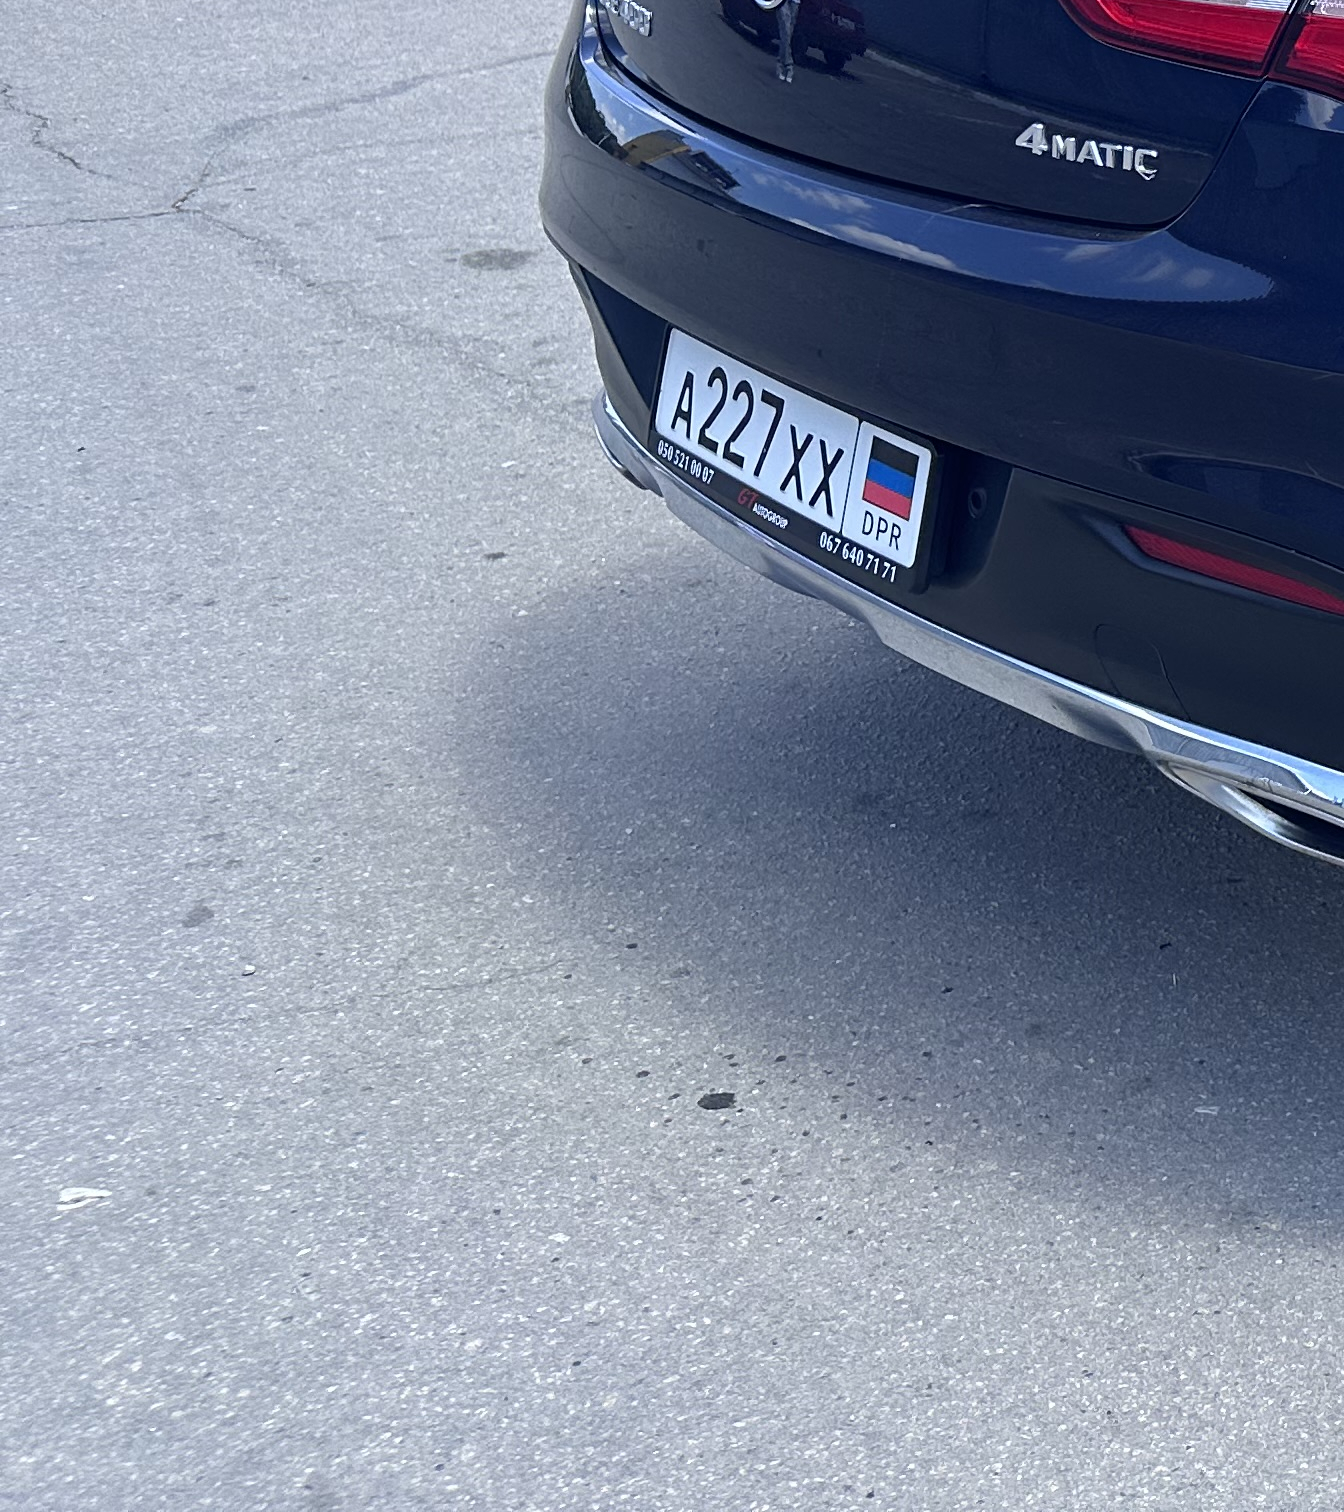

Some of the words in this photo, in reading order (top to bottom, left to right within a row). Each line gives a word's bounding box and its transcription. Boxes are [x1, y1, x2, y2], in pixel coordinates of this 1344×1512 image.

[1015, 123, 1158, 181] 4MATIC
[658, 439, 674, 462] 050
[675, 448, 689, 471] 521
[690, 459, 702, 479] 00
[702, 466, 715, 485] 07
[861, 510, 902, 551] DPR
[819, 531, 841, 554] 067
[842, 545, 864, 568] 640
[866, 554, 880, 577] 71
[882, 563, 897, 583] 71
